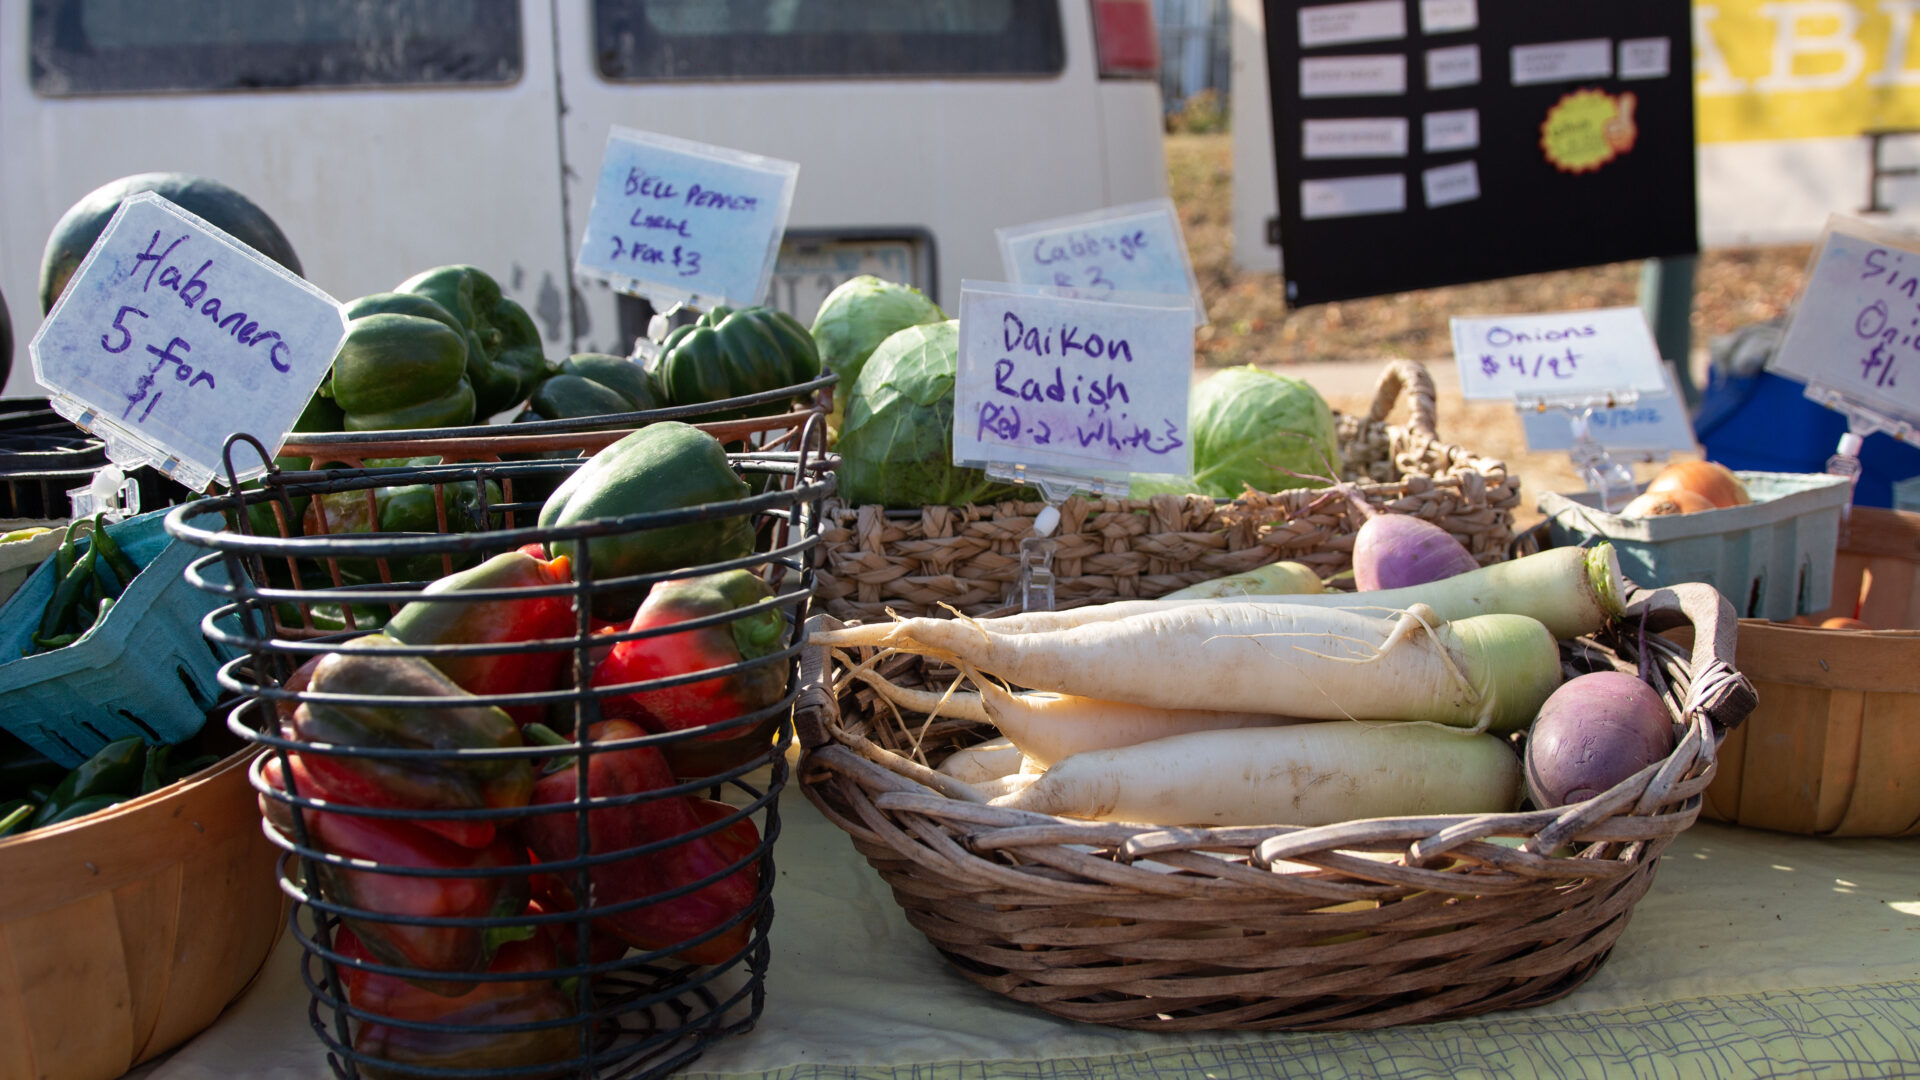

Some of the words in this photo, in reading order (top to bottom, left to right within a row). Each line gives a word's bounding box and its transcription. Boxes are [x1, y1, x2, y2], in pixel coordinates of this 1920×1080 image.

[625, 167, 679, 199] BELL
[672, 245, 702, 276] $3
[1034, 229, 1149, 266] Cabbage
[1860, 248, 1920, 312] Sin
[101, 305, 149, 354] 5
[1486, 324, 1597, 346] Onions
[994, 357, 1130, 405] Radish
